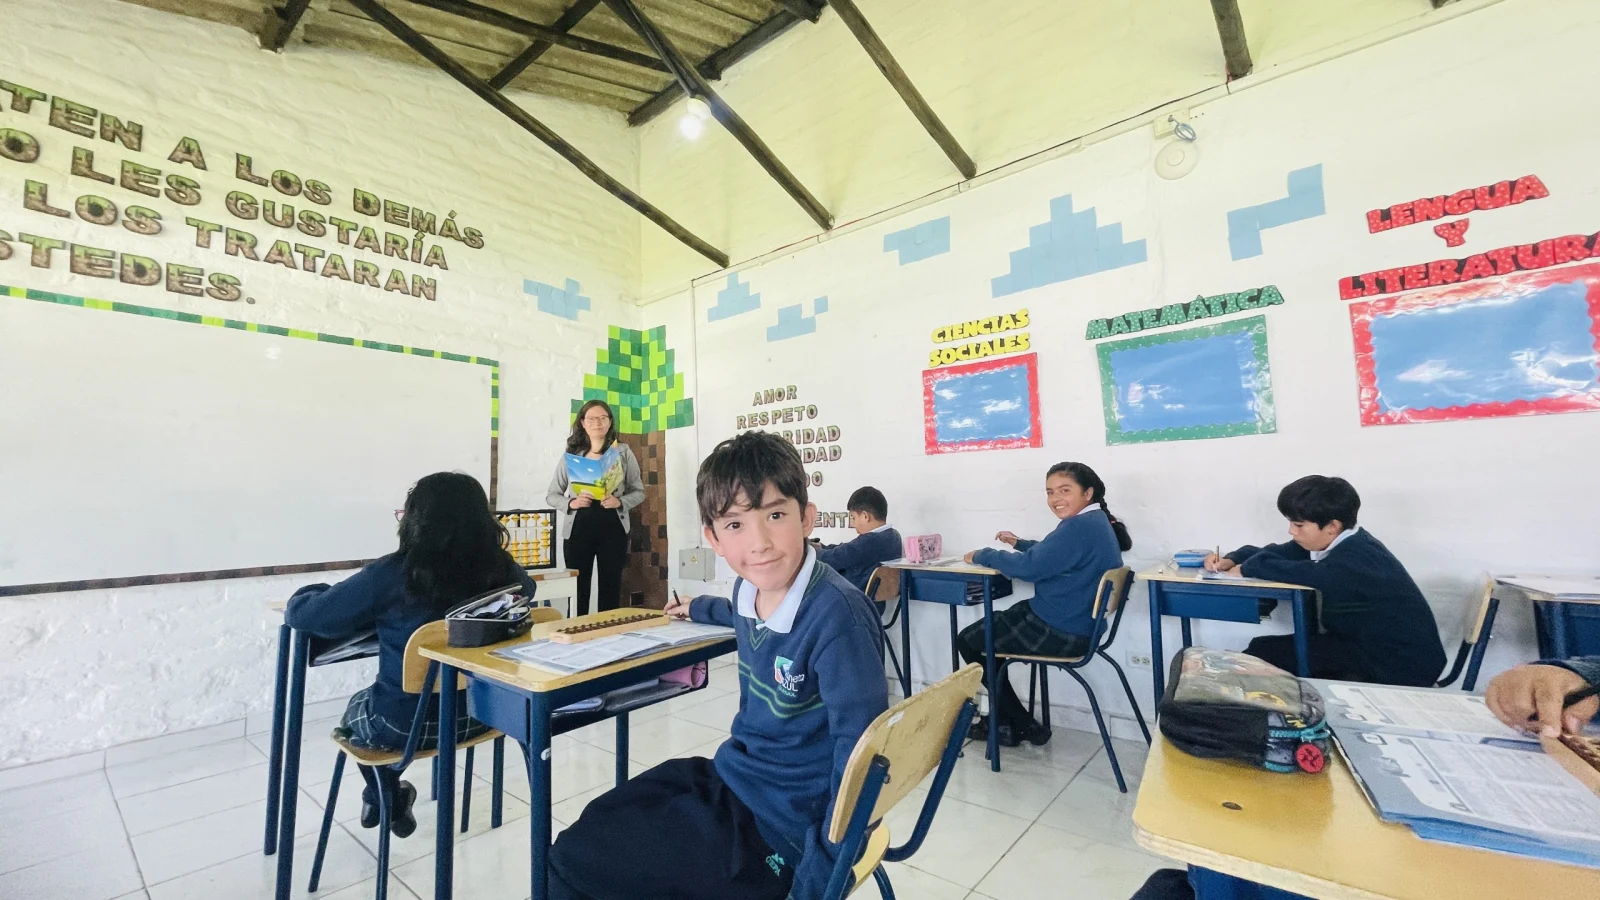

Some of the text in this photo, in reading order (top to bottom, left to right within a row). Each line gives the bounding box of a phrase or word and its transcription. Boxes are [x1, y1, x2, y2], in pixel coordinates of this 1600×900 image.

[0, 78, 485, 249] TEN A LOS DEMÁS
[71, 145, 201, 206] LES
[225, 190, 448, 271] GUSTARÍA
[1365, 174, 1550, 234] LENGUA
[23, 179, 437, 301] LOS TRATARAN
[1433, 218, 1470, 248] Y
[1338, 230, 1600, 301] LITERATUR
[931, 308, 1030, 344] CIENCIAS
[1085, 284, 1285, 341] MATEMÁTICA
[928, 332, 1031, 369] SOCIALES
[736, 404, 818, 430] RESPETO
[753, 385, 797, 406] AMOR
